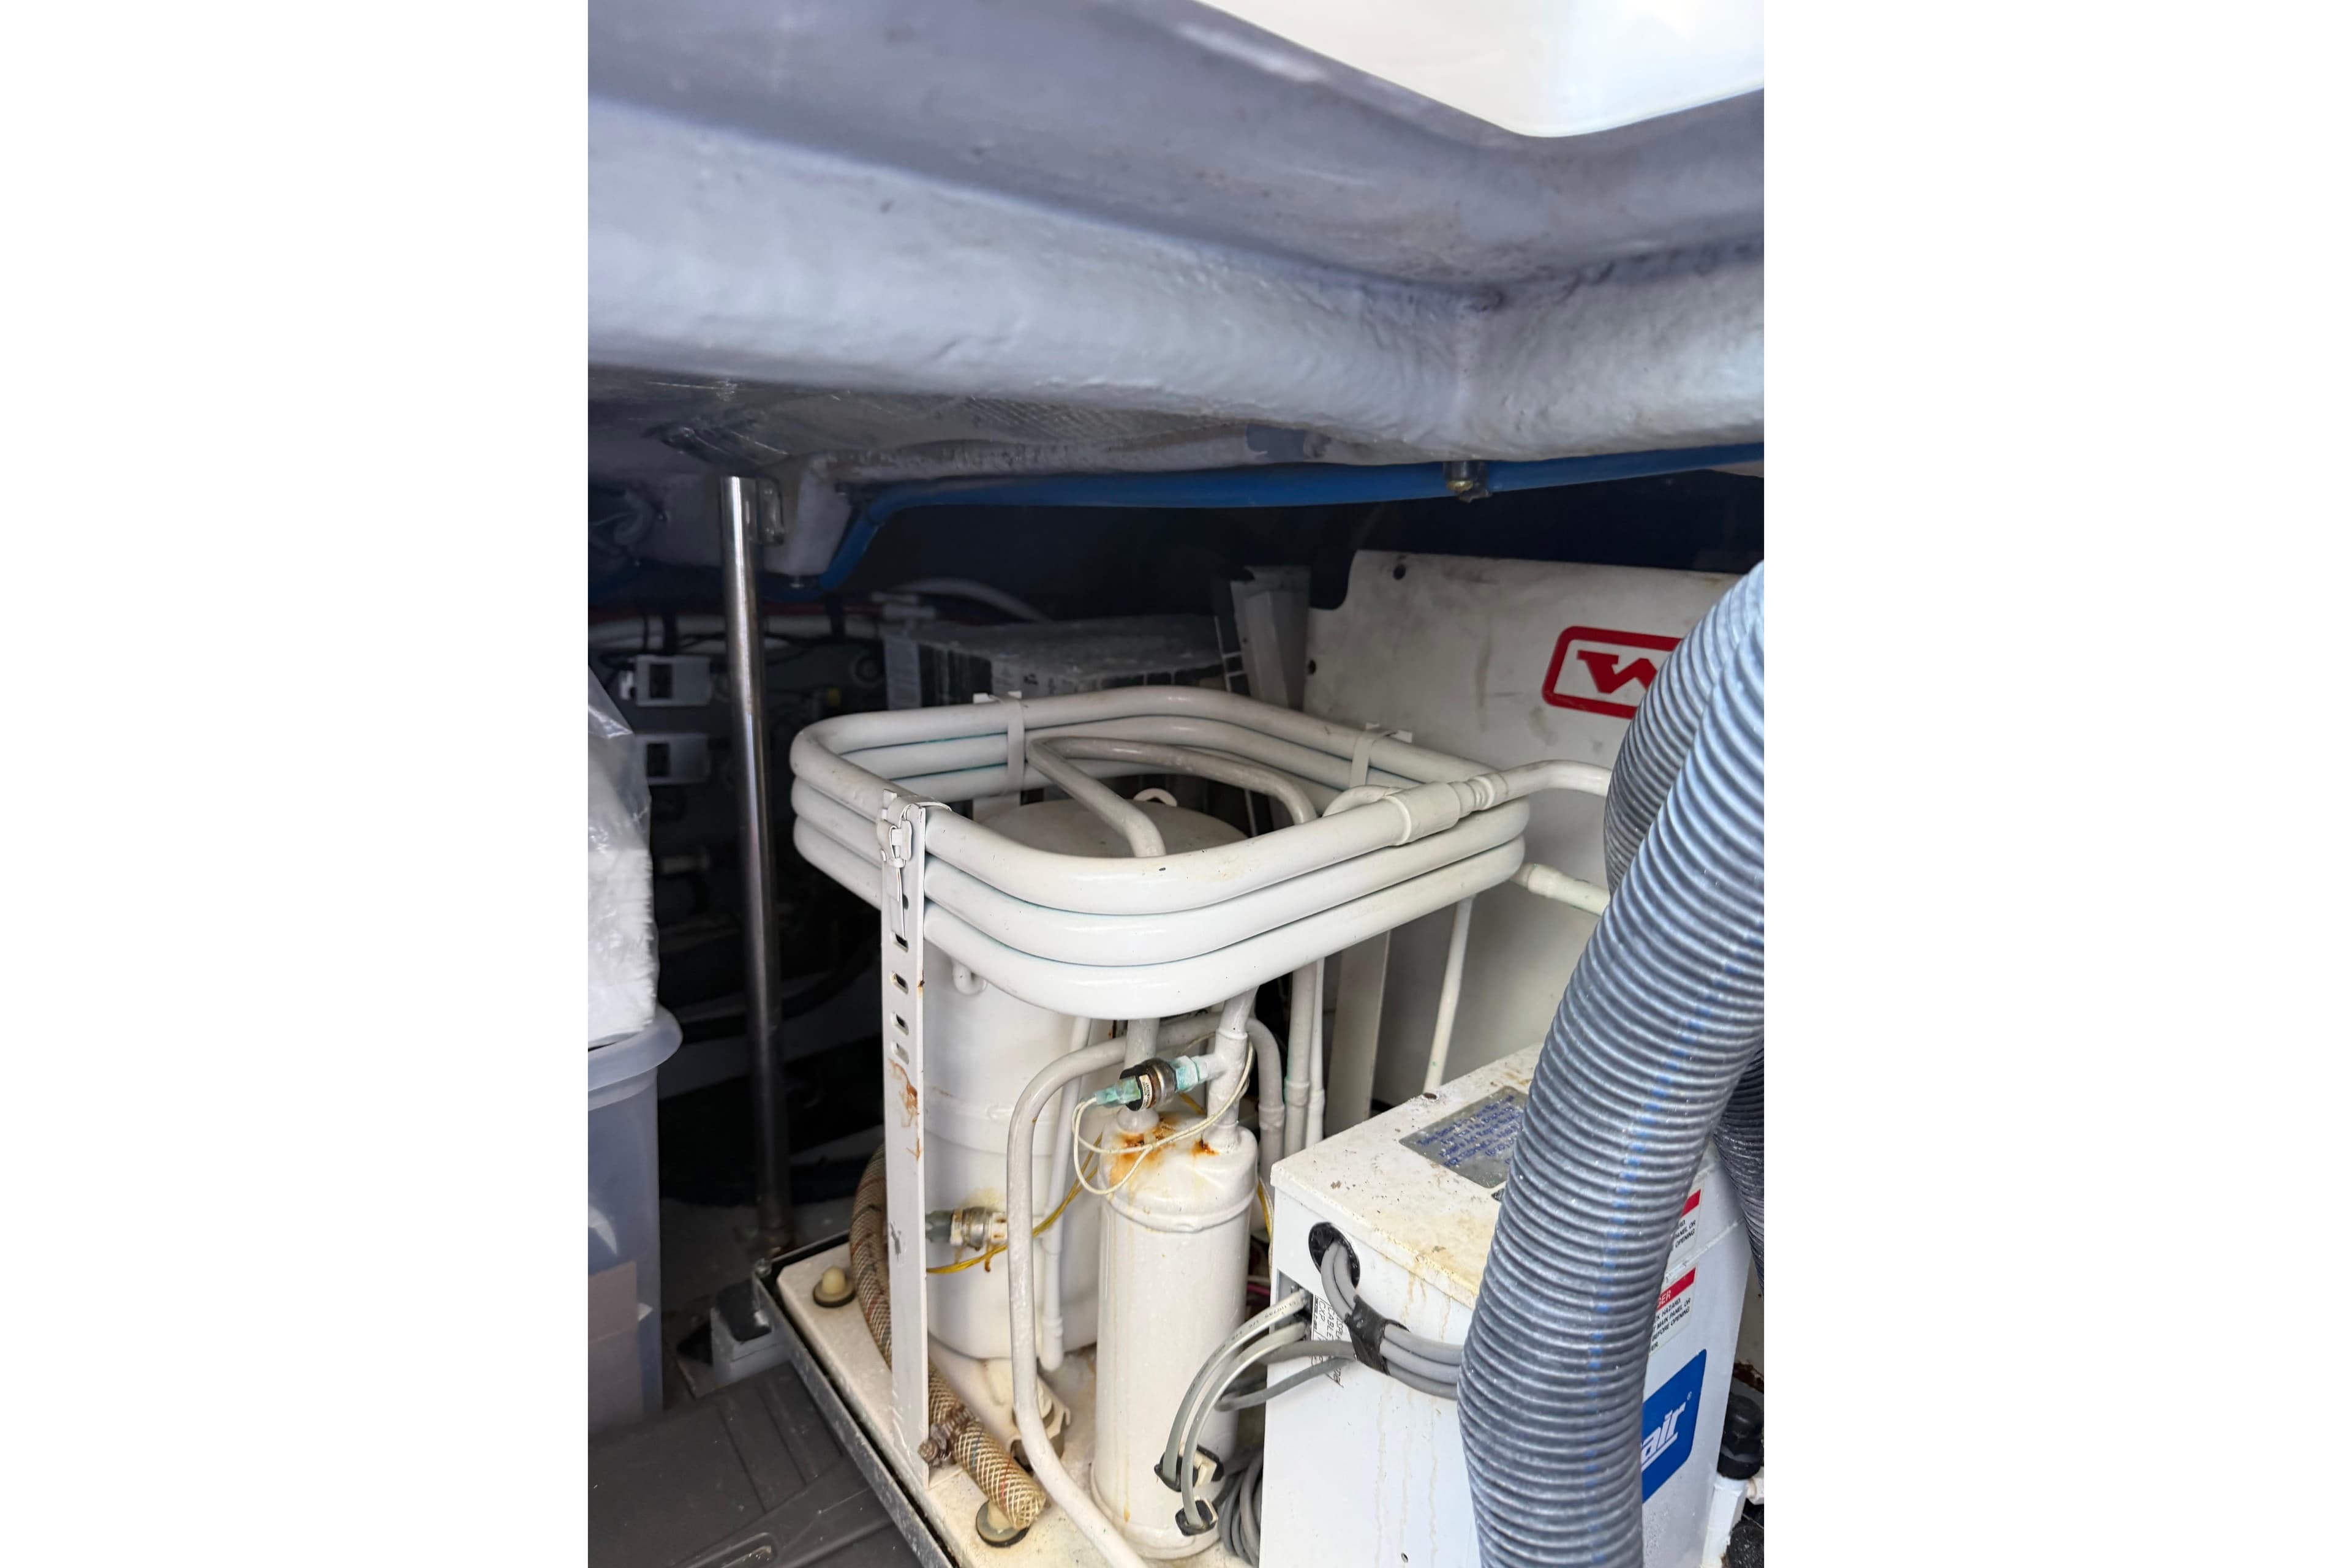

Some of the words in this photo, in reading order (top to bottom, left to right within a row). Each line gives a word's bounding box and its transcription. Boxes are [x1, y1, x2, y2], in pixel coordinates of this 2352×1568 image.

[1675, 1228, 1695, 1248] OPENING
[1657, 1316, 1669, 1329] MAIN
[1669, 1305, 1683, 1320] PANEL
[1670, 1306, 1690, 1326] OPENING
